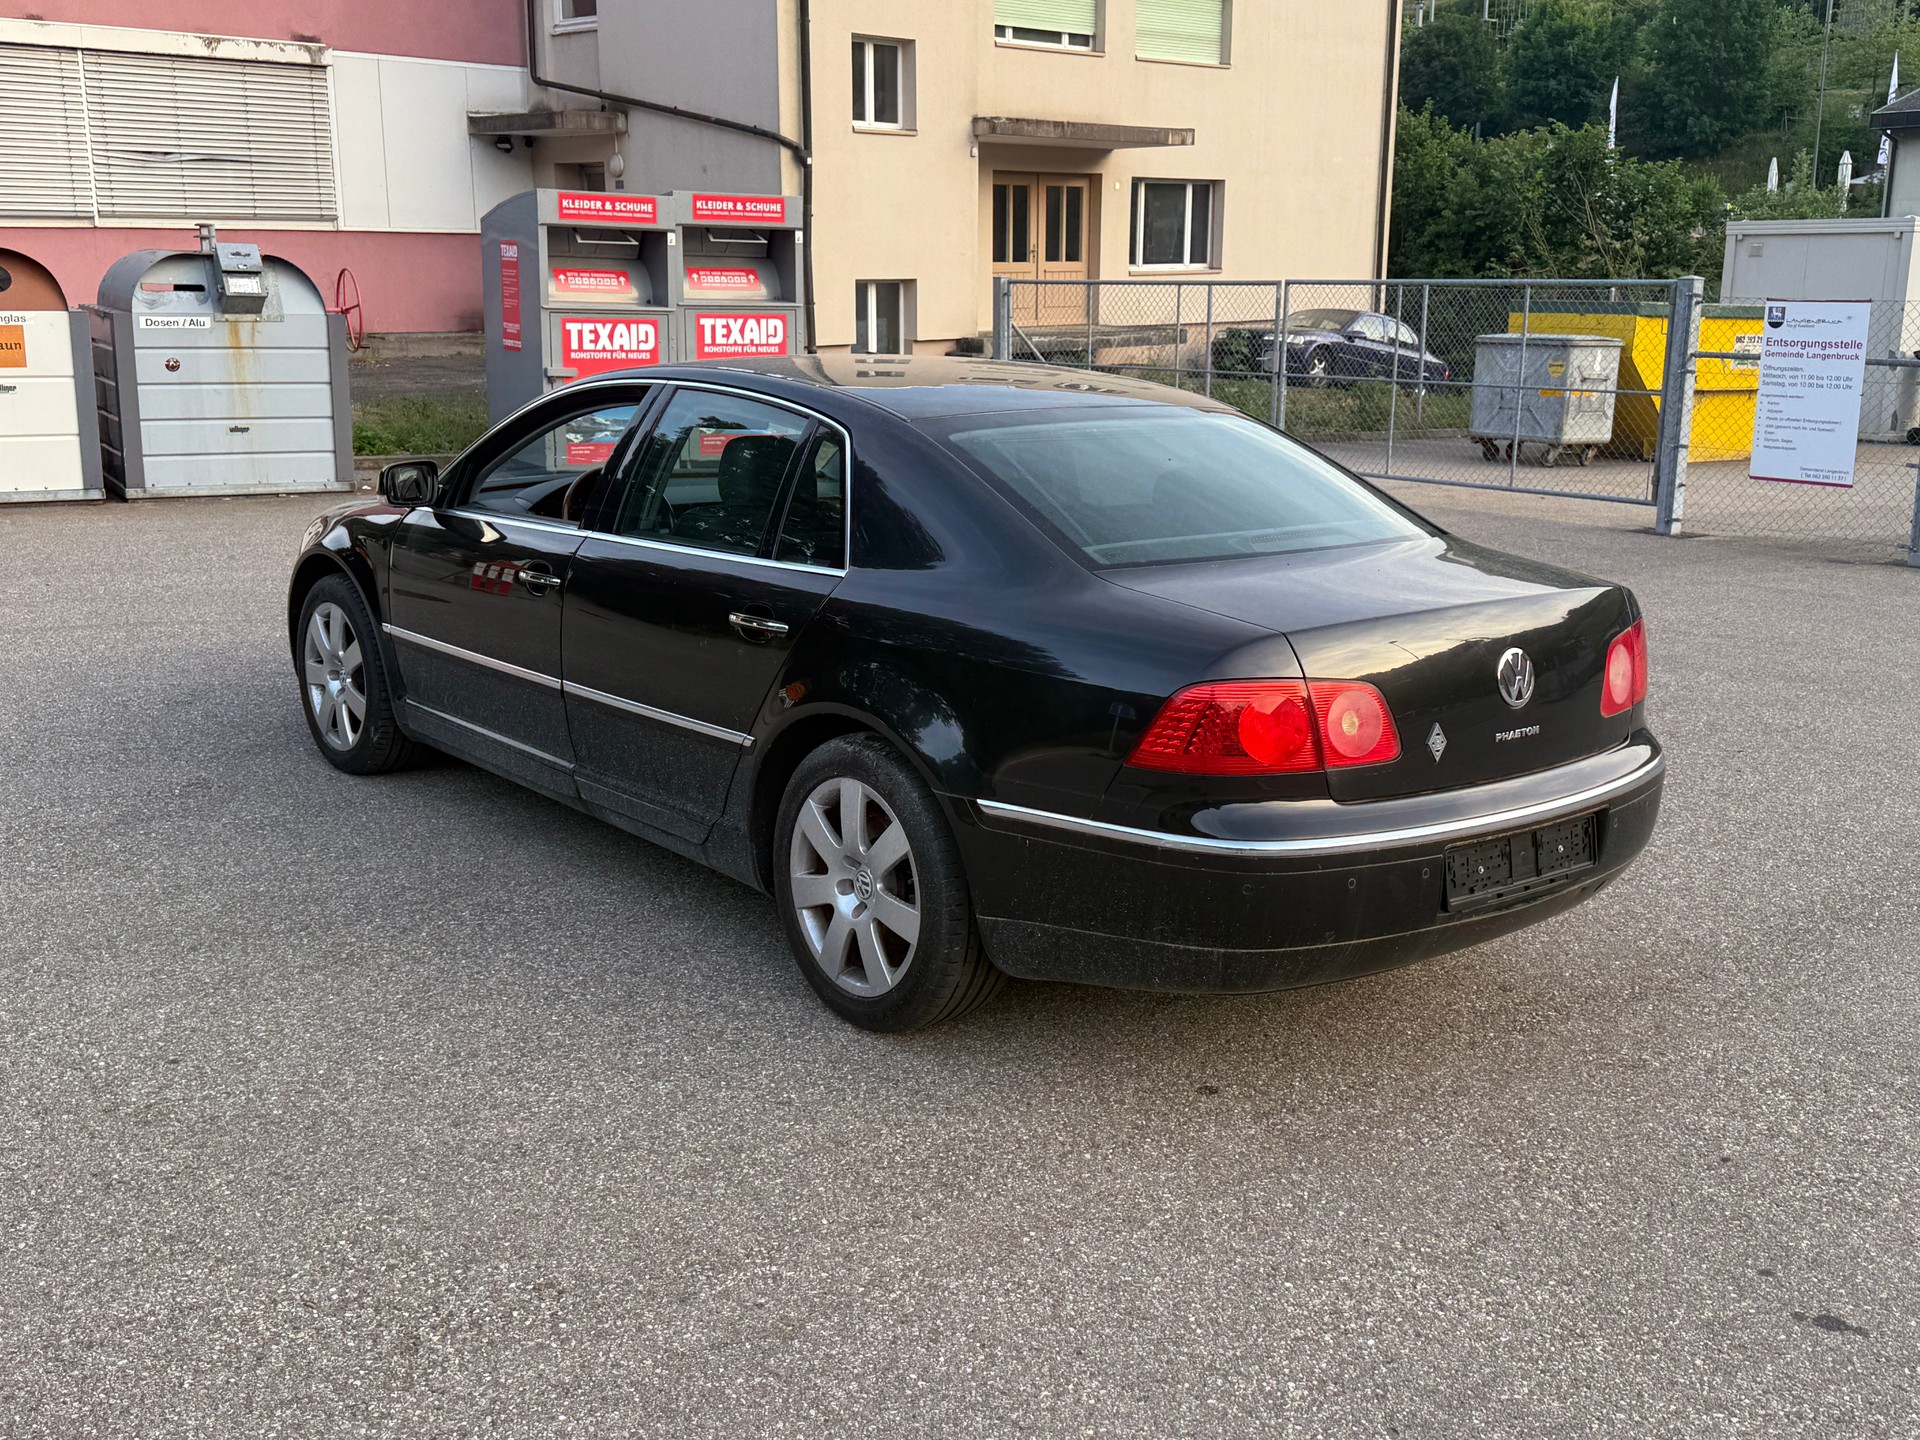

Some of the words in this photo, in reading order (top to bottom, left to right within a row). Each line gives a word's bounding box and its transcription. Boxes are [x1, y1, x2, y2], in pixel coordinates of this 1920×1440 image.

[562, 198, 603, 210] KLEIDER
[605, 201, 613, 211] &
[615, 201, 654, 213] SCHUHE
[696, 200, 734, 211] KLEIDER
[736, 201, 744, 211] &
[746, 202, 782, 213] SCHUHE
[501, 244, 518, 257] TEXAID
[145, 318, 179, 327] Dosen
[182, 318, 186, 327] /
[188, 318, 206, 327] Alu
[565, 322, 656, 351] TEXAID
[699, 317, 784, 344] TEXAID
[704, 345, 742, 353] ROHSTOFFE
[743, 344, 757, 353] FÜR
[757, 345, 779, 353] NEUES
[1765, 337, 1863, 350] Entsorgungsstelle
[612, 351, 627, 360] FÜR
[627, 352, 651, 360] NEUES
[1764, 350, 1804, 359] Gemeinde
[1806, 352, 1860, 361] Langenbruck
[1495, 725, 1540, 743] PHAETON
